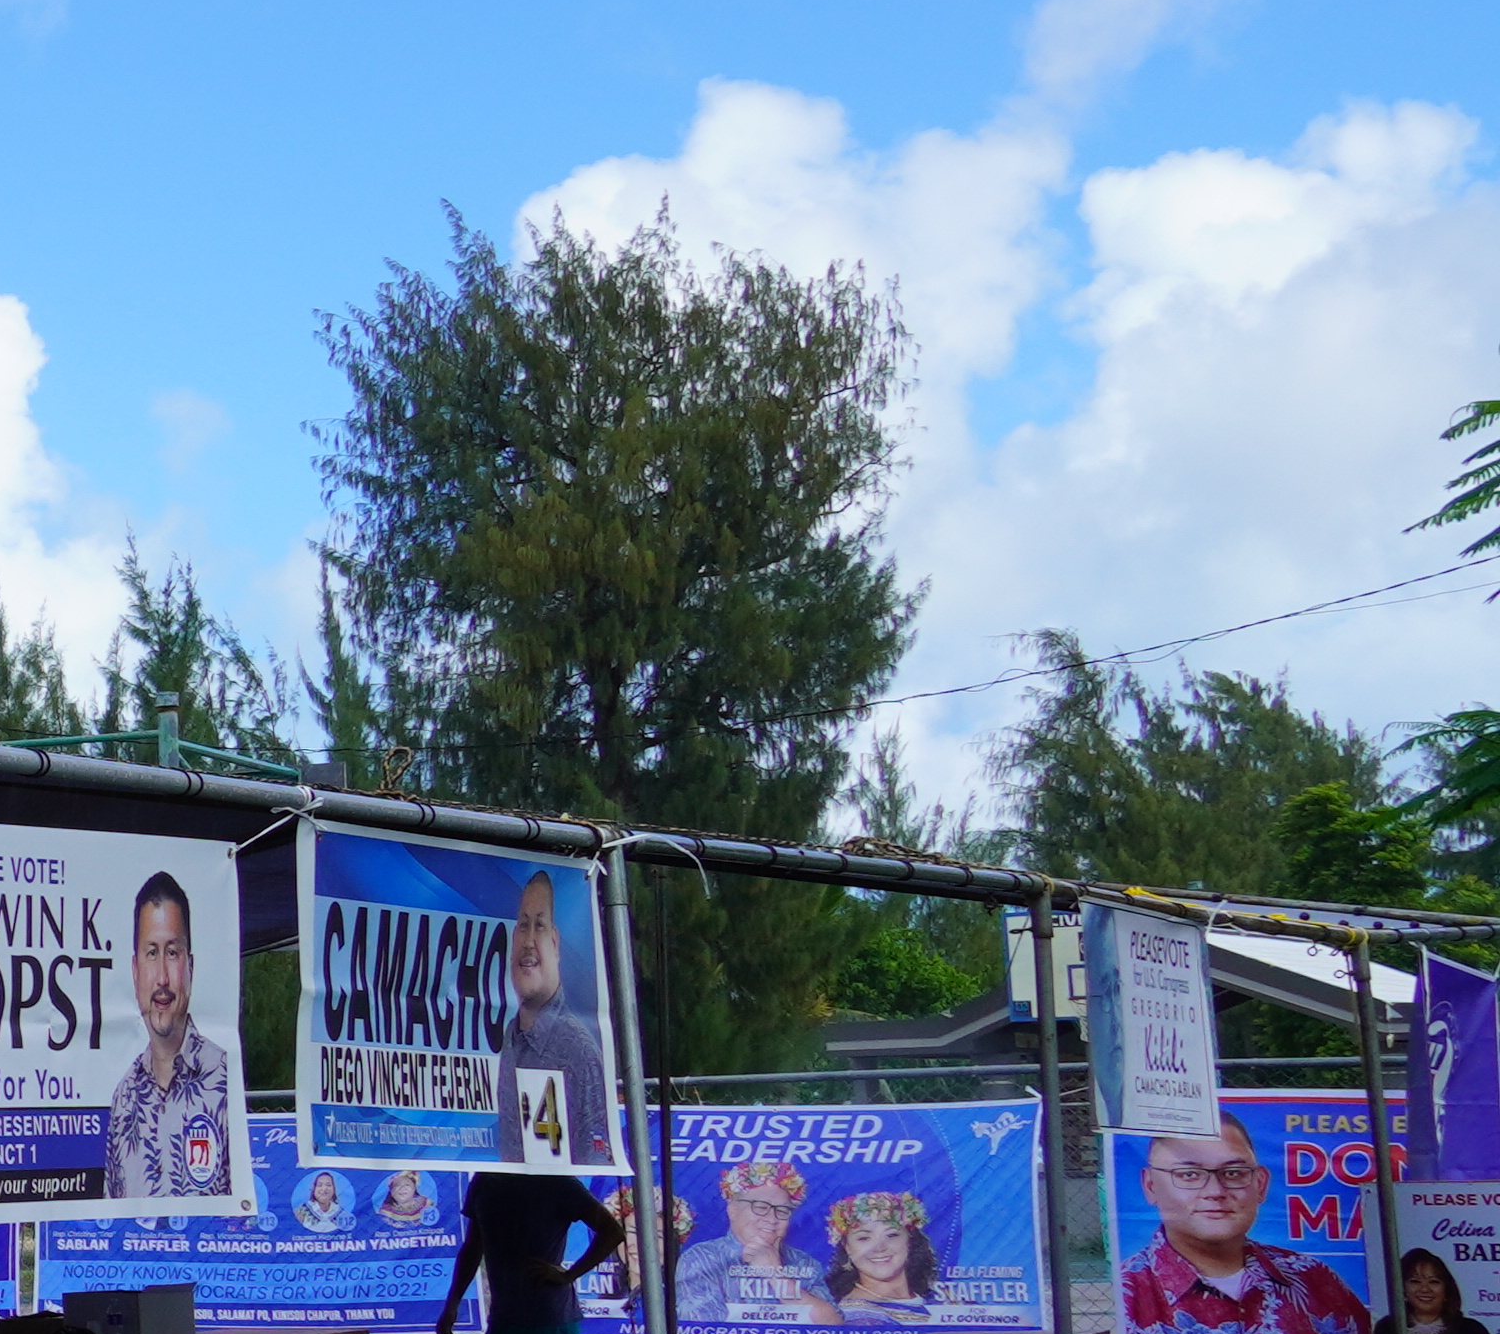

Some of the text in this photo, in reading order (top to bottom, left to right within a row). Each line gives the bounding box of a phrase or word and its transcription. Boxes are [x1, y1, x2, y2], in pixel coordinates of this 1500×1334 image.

[10, 855, 66, 885] VOTE!
[81, 898, 113, 952] K.
[1130, 930, 1190, 969] PLEASE VOTE
[323, 901, 509, 1054] CAMACHO
[1131, 997, 1196, 1024] GREGORIO
[1144, 1023, 1188, 1074] Kilili
[35, 1069, 82, 1100] You.
[321, 1045, 494, 1112] DIEGO VINCENT FEJERAN
[676, 1114, 883, 1139] TRUSTED
[29, 1142, 38, 1165] 1
[30, 1172, 87, 1199] support!
[1412, 1193, 1477, 1206] PLEASE
[1431, 1218, 1496, 1242] Celina
[57, 1238, 109, 1251] SABLAN
[123, 1239, 191, 1253] STAFFLER
[197, 1240, 272, 1254] CAMACHO
[275, 1240, 366, 1254] PANGELINAN
[369, 1234, 457, 1251] YANGETMAI
[63, 1263, 448, 1282] NOBODY KNOWS WHERE YOUR PENCILS GOES.
[777, 1266, 815, 1279] SABLAN
[946, 1266, 1023, 1279] LEILA FLEMING
[272, 1282, 429, 1300] FOR YOU IN 2022!
[933, 1281, 1029, 1303] STAFFLER
[217, 1307, 256, 1322] SALAMAT
[345, 1309, 375, 1321] THANK
[374, 1308, 395, 1320] YOU
[741, 1311, 798, 1321] DELEGATE
[940, 1314, 1019, 1324] LT. GOVERNOR
